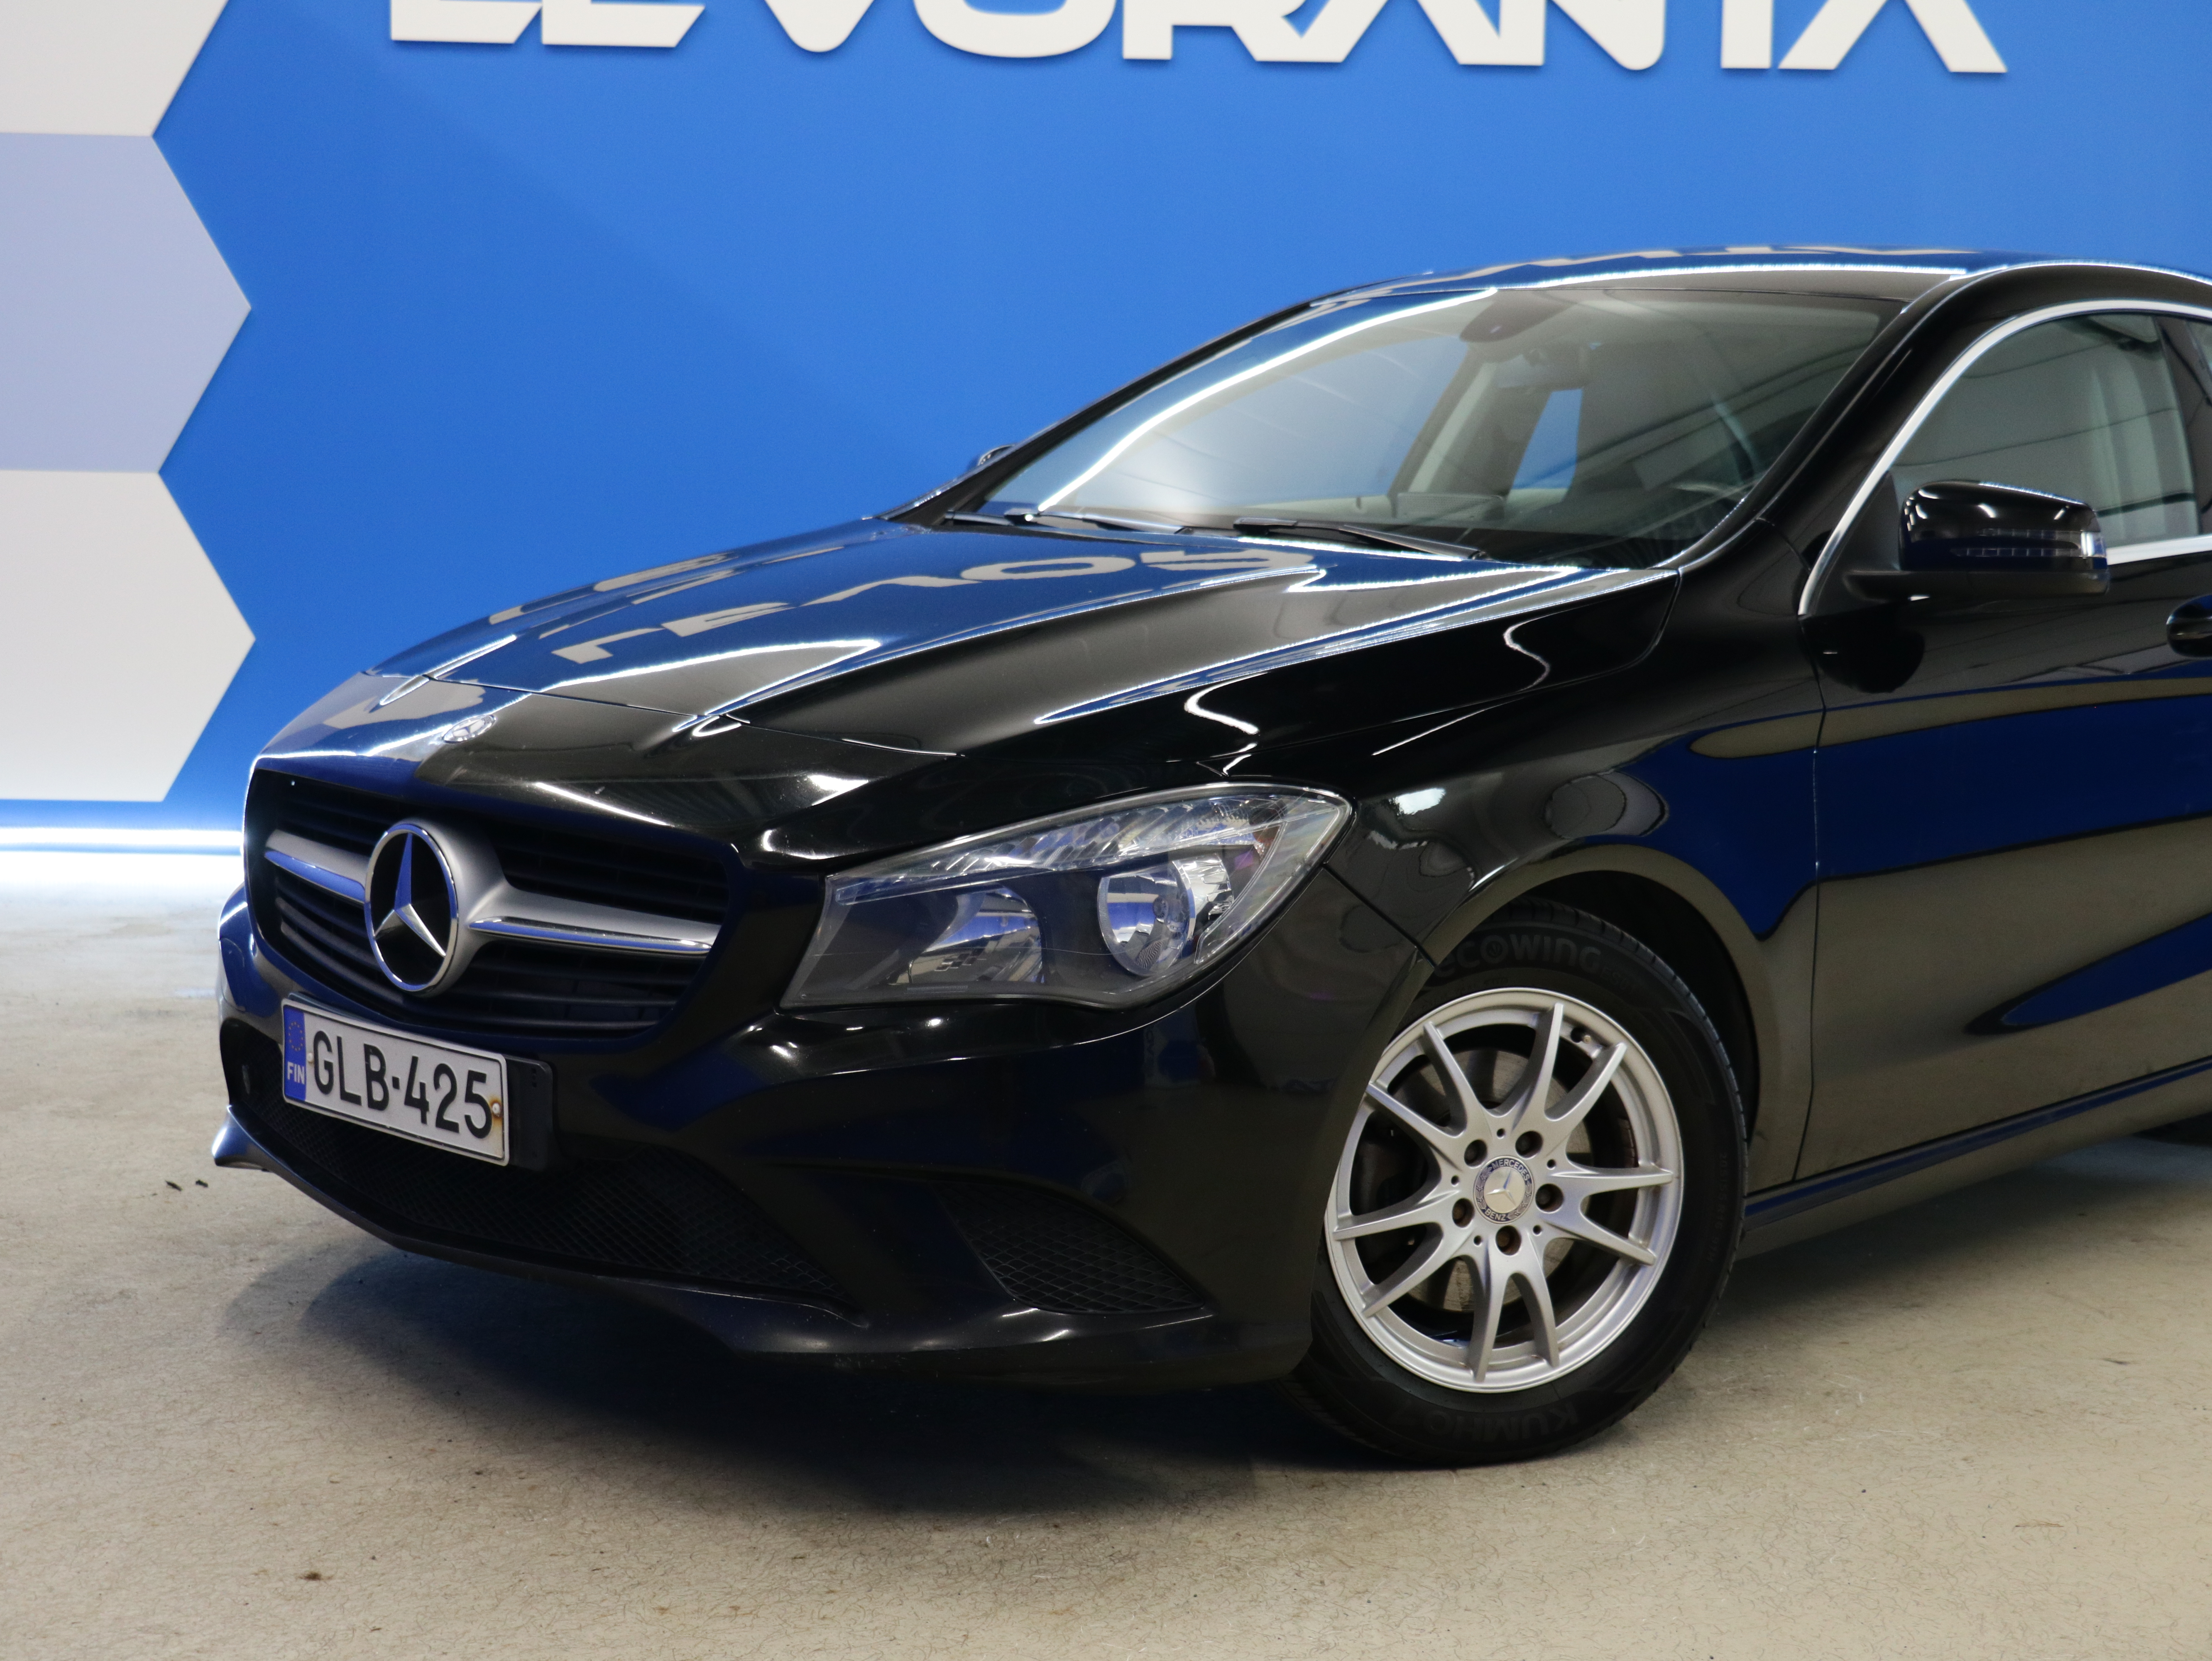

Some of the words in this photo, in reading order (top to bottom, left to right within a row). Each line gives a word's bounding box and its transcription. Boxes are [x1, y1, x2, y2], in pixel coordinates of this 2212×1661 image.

[287, 1061, 305, 1085] FIN
[313, 1030, 493, 1139] GLB-425
[1491, 1159, 1530, 1181] MERCEDES
[1485, 1208, 1507, 1221] BENZ
[1424, 1402, 1578, 1442] KUMHO
